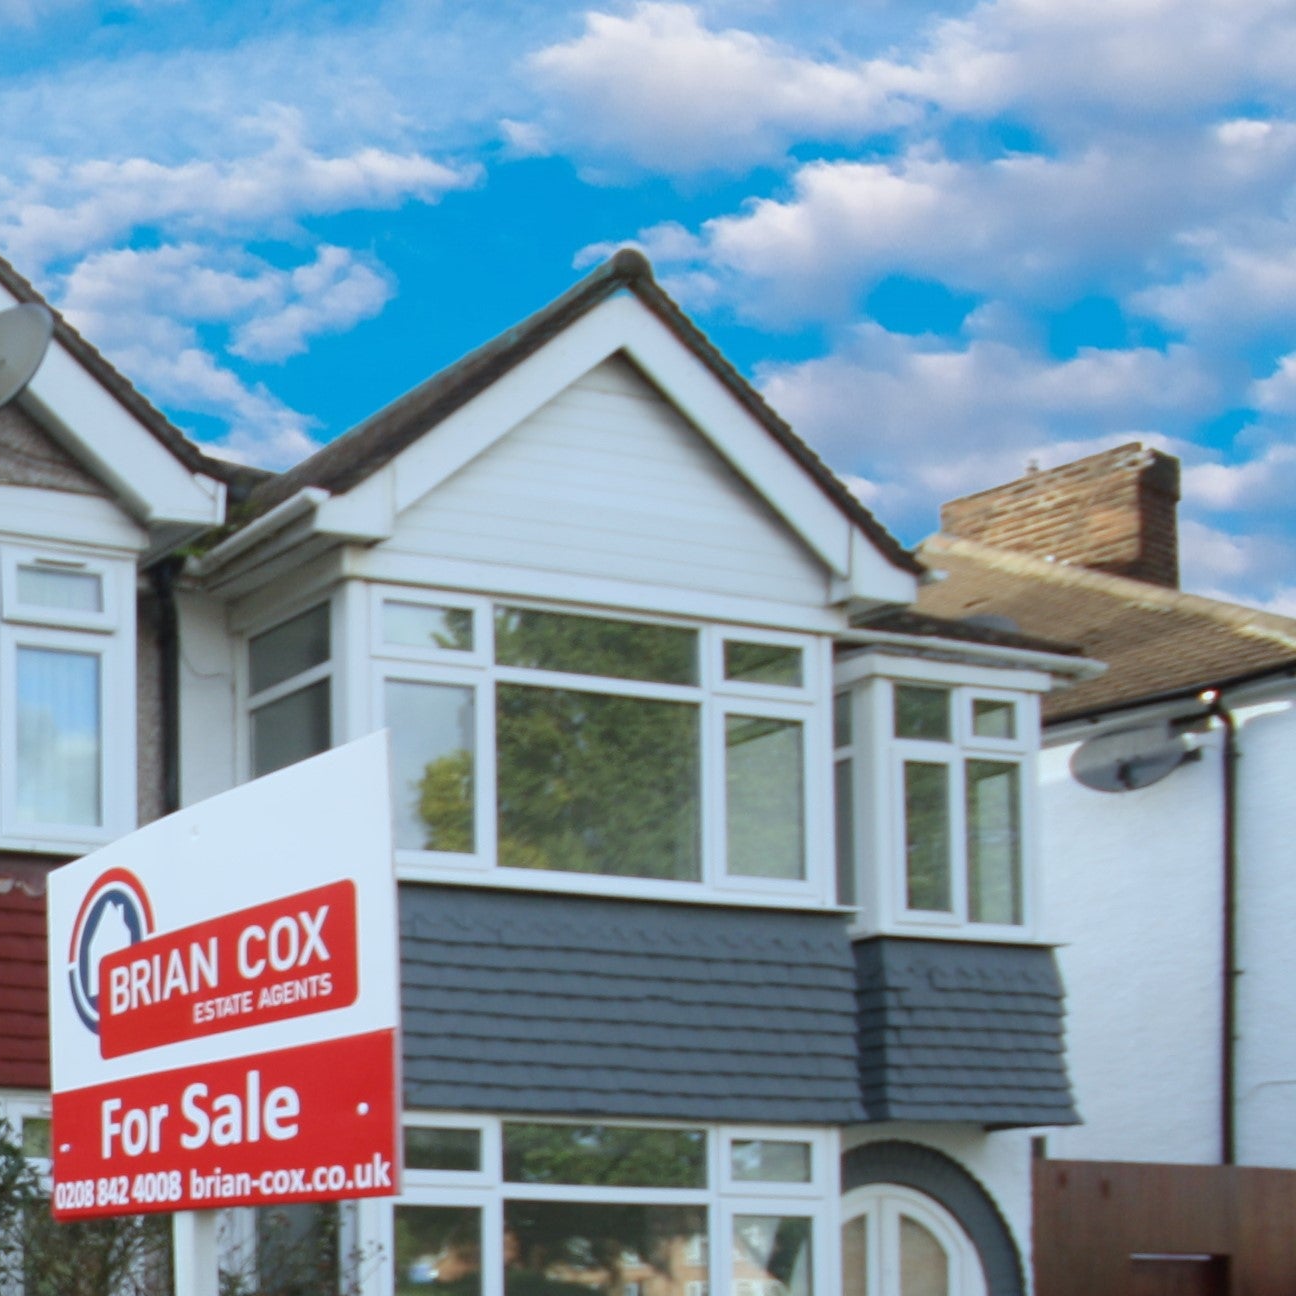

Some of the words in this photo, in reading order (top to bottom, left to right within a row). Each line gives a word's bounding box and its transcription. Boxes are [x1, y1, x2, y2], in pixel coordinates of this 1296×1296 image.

[109, 936, 218, 1016] BRIAN
[237, 905, 330, 980] COX
[193, 990, 254, 1024] ESTATE
[258, 973, 333, 1009] AGENTS
[101, 1097, 169, 1160] For
[180, 1069, 301, 1150] Sale
[55, 1179, 94, 1210] 0208
[96, 1175, 130, 1206] 842
[131, 1169, 182, 1203] 4008
[189, 1152, 392, 1200] brian-cox.co.uk
